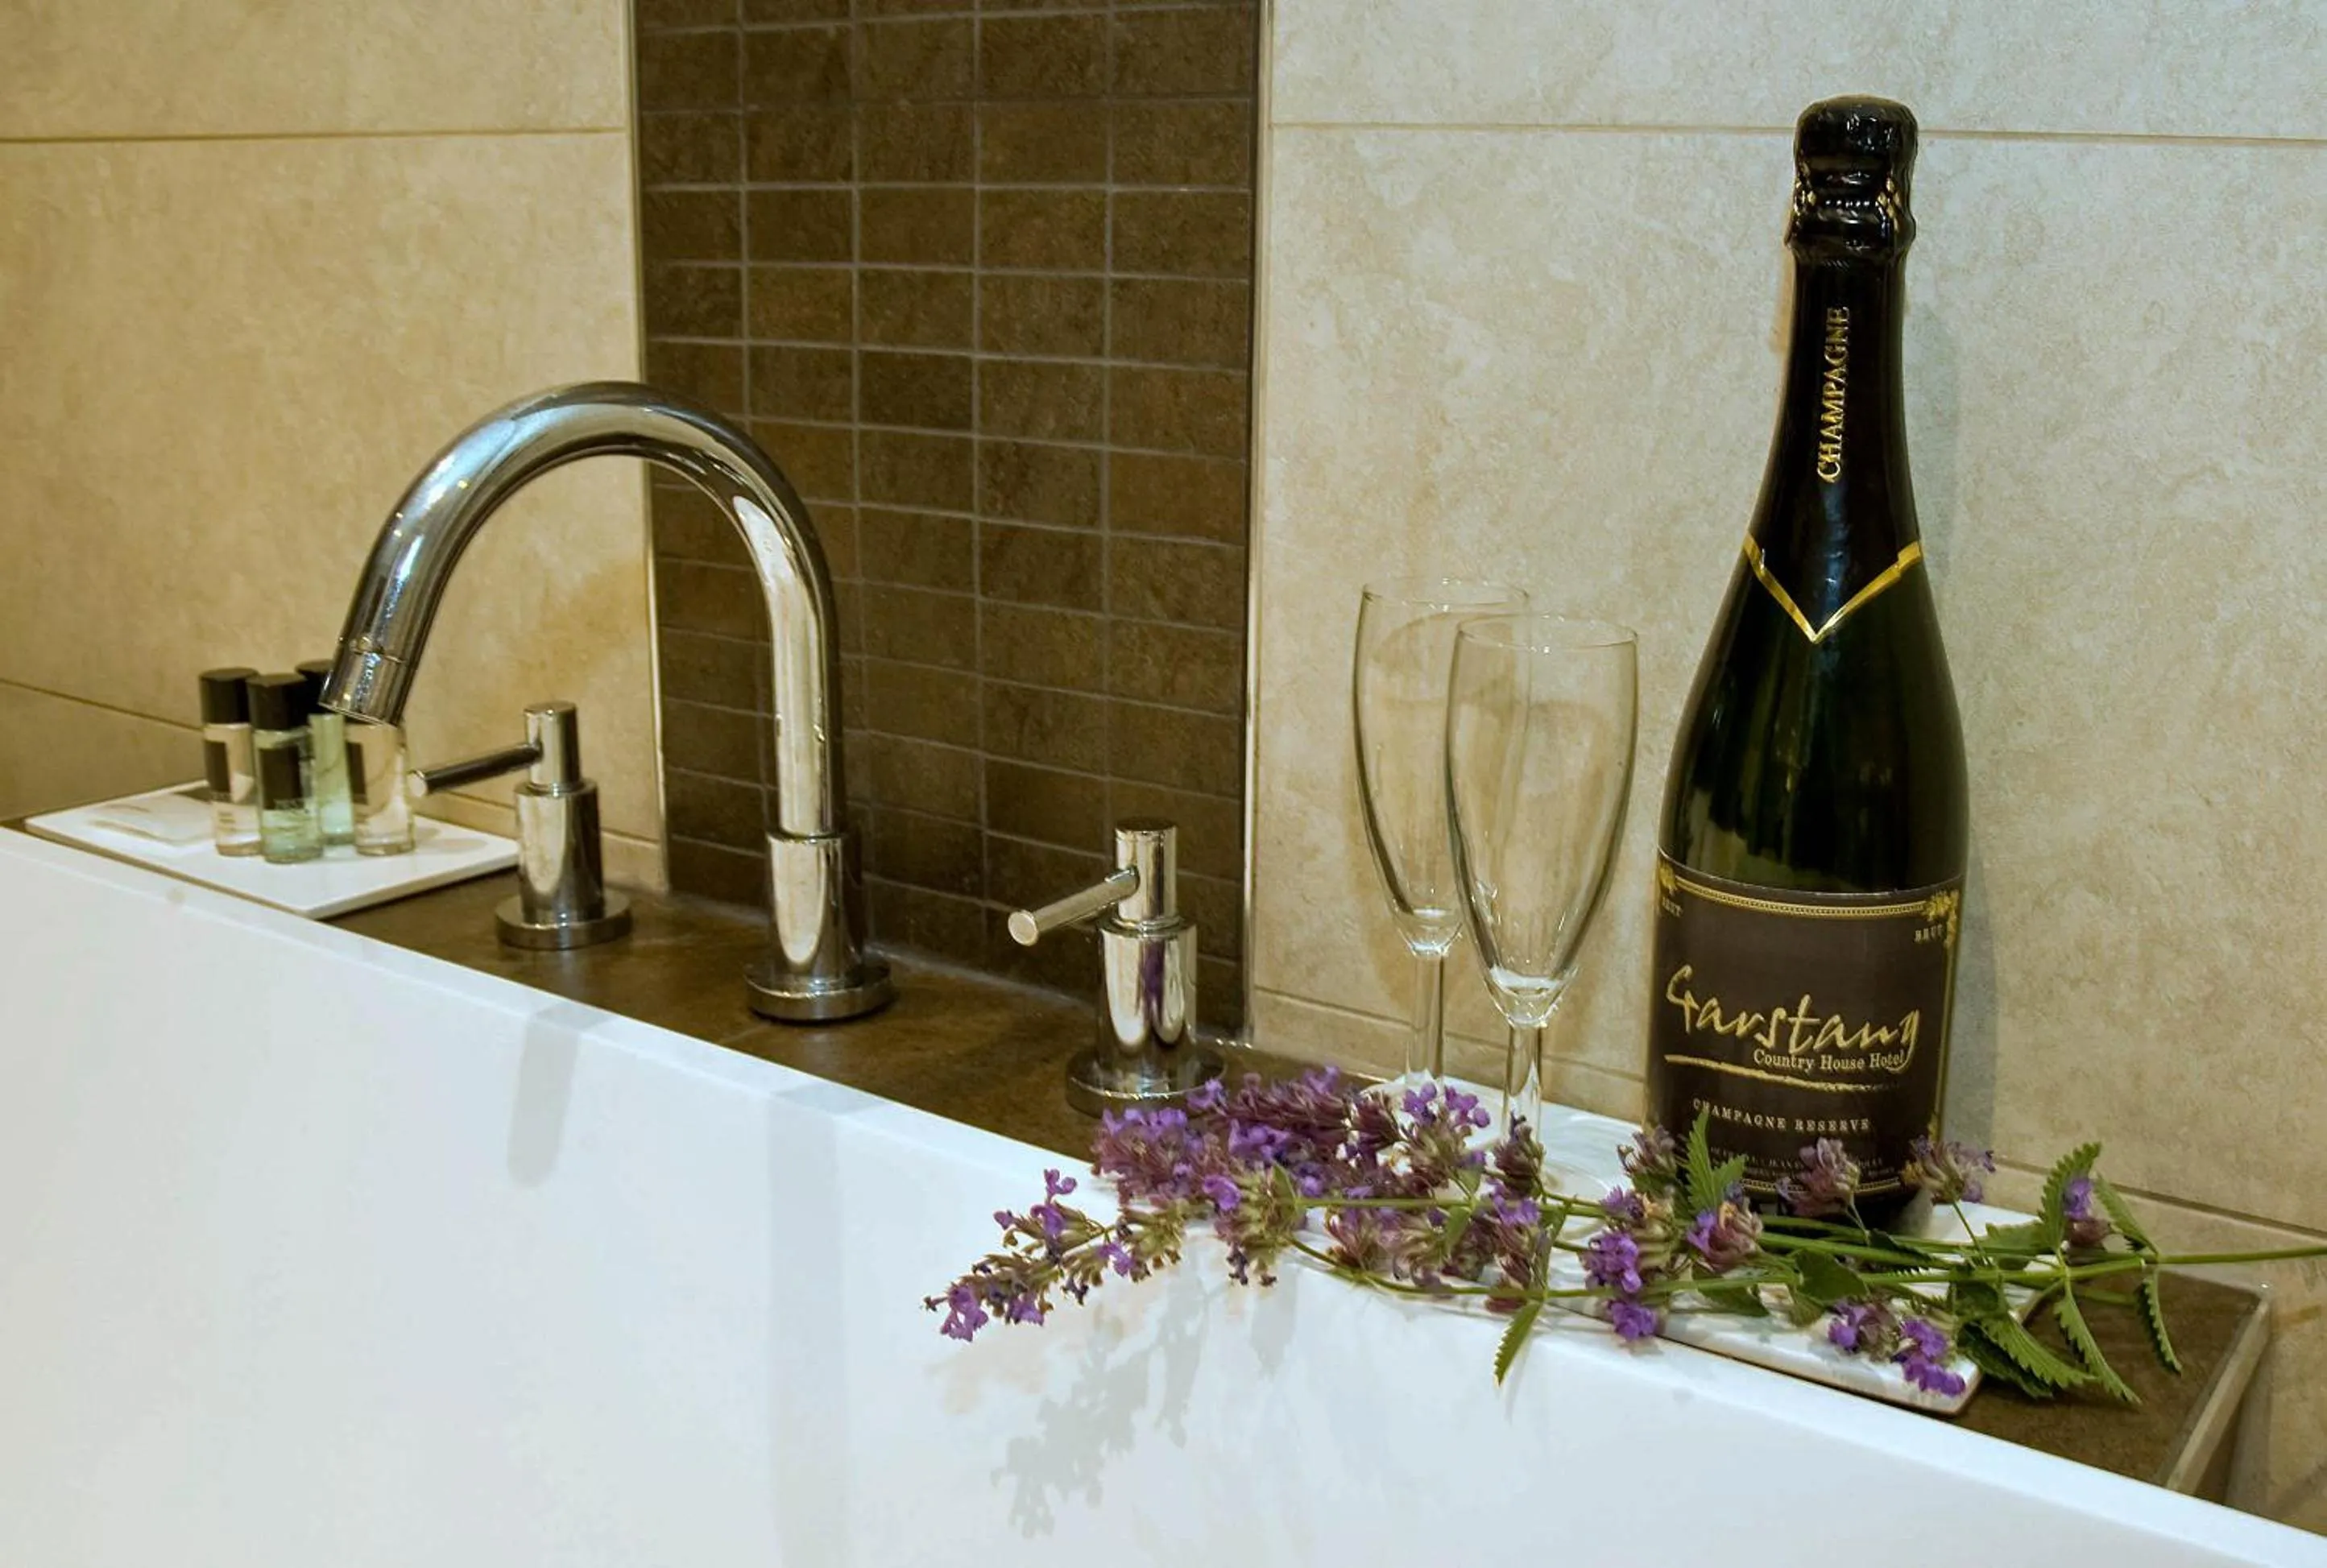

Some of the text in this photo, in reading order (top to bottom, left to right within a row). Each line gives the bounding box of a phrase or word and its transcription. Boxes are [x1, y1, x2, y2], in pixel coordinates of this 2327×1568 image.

[1816, 306, 1850, 483] CHAMPAGNE
[1666, 964, 1920, 1074] Garstang
[1754, 1049, 1904, 1073] Country House Hotel
[1795, 1118, 1869, 1132] RESERVE
